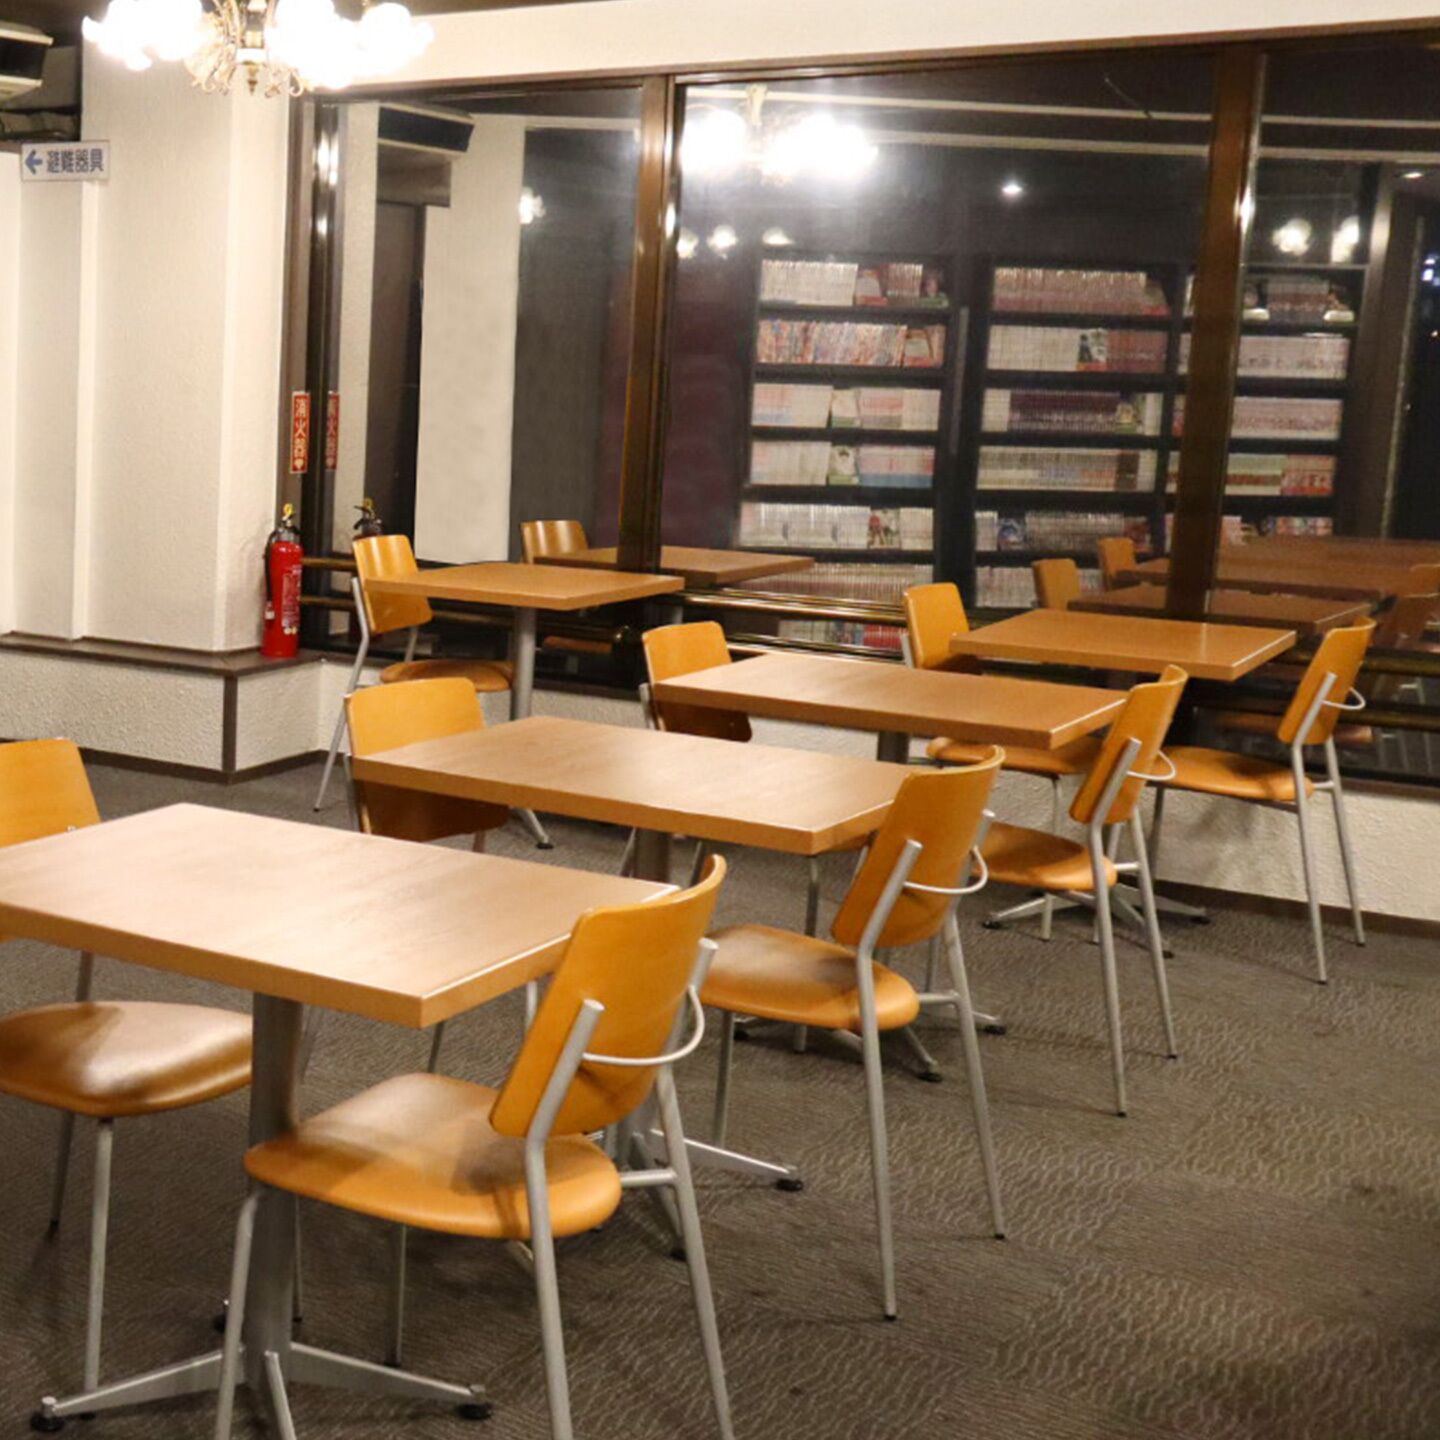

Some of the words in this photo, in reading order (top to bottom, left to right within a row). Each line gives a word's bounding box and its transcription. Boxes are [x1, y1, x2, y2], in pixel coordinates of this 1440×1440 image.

[46, 148, 104, 174] 避難器具
[294, 397, 307, 458] 消火器
